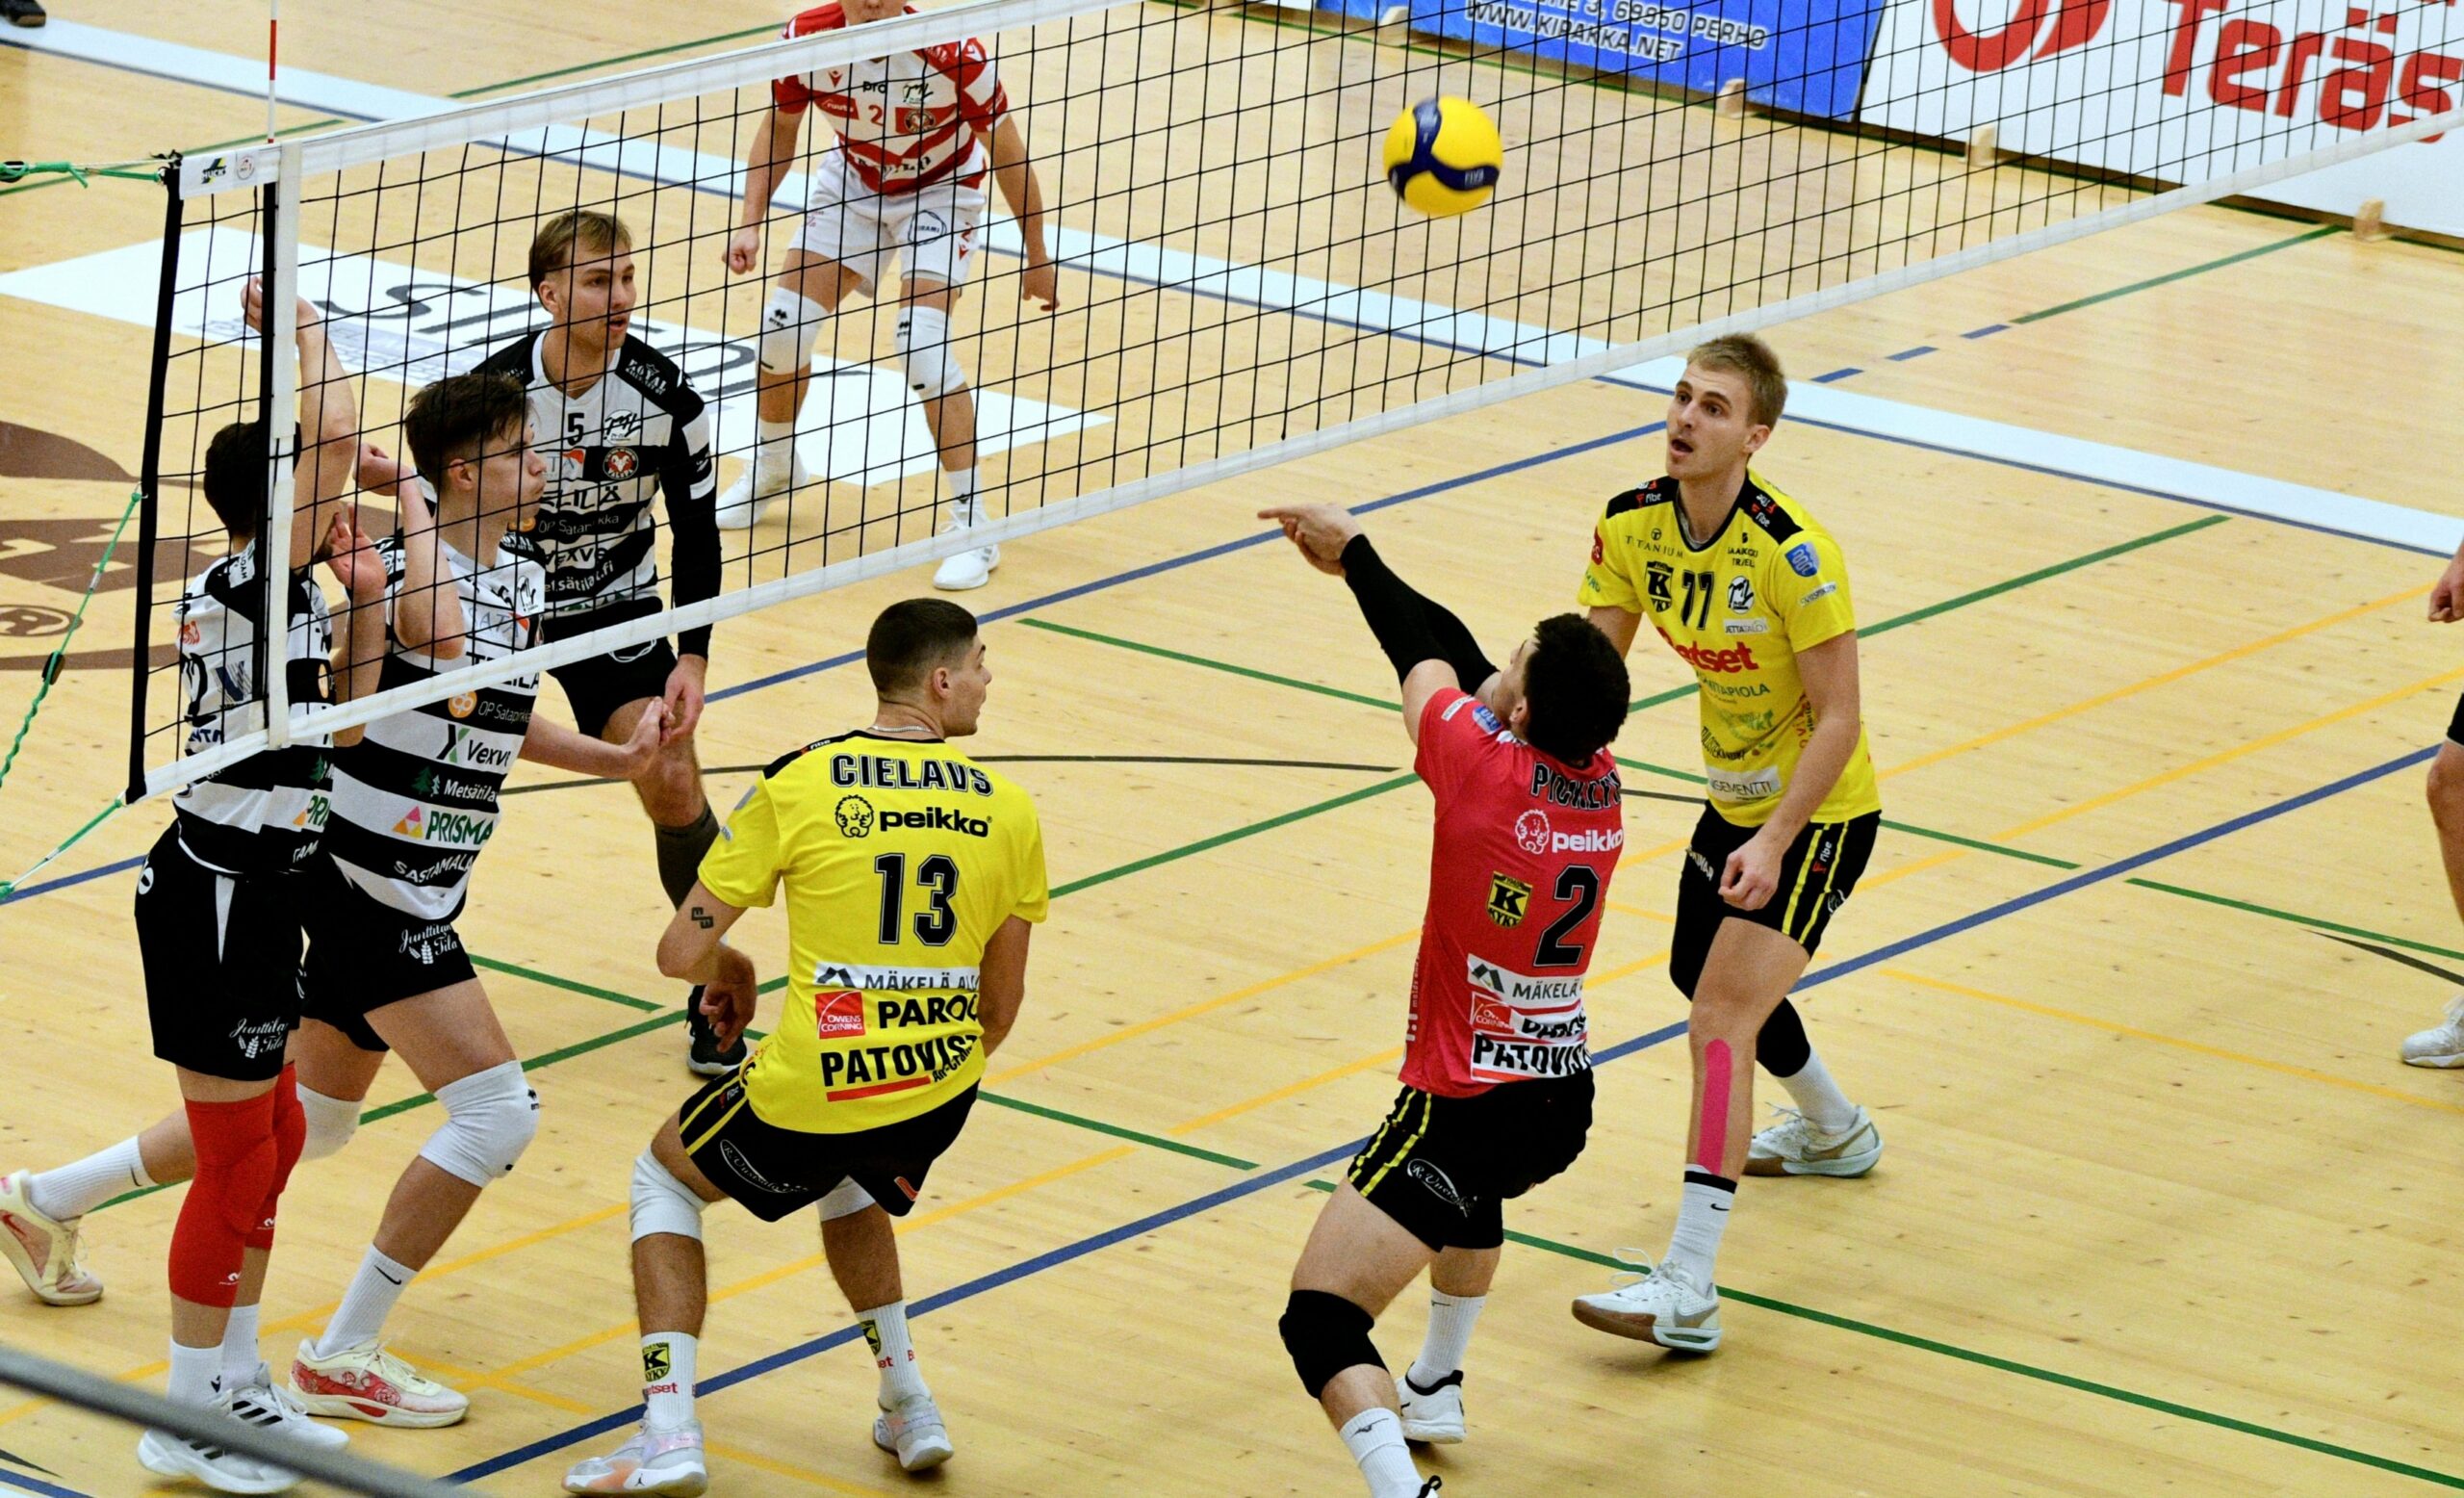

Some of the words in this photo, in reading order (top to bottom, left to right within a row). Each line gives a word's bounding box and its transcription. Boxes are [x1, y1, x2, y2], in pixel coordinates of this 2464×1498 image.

[1466, 3, 1683, 65] WWW.KIPAKKA.NET
[1690, 15, 1767, 49] PERHO
[2162, 0, 2463, 143] Teräs
[568, 412, 585, 446] 5
[1681, 569, 1714, 631] 77
[831, 753, 993, 797] CIELAVS
[425, 811, 493, 845] PRISMA
[879, 807, 989, 838] peikko
[1552, 829, 1624, 853] peikko
[874, 853, 960, 947] 13
[1533, 865, 1600, 968] 2
[865, 970, 951, 991] MÄKELÄ
[1512, 979, 1578, 1001] MÄKELÄ
